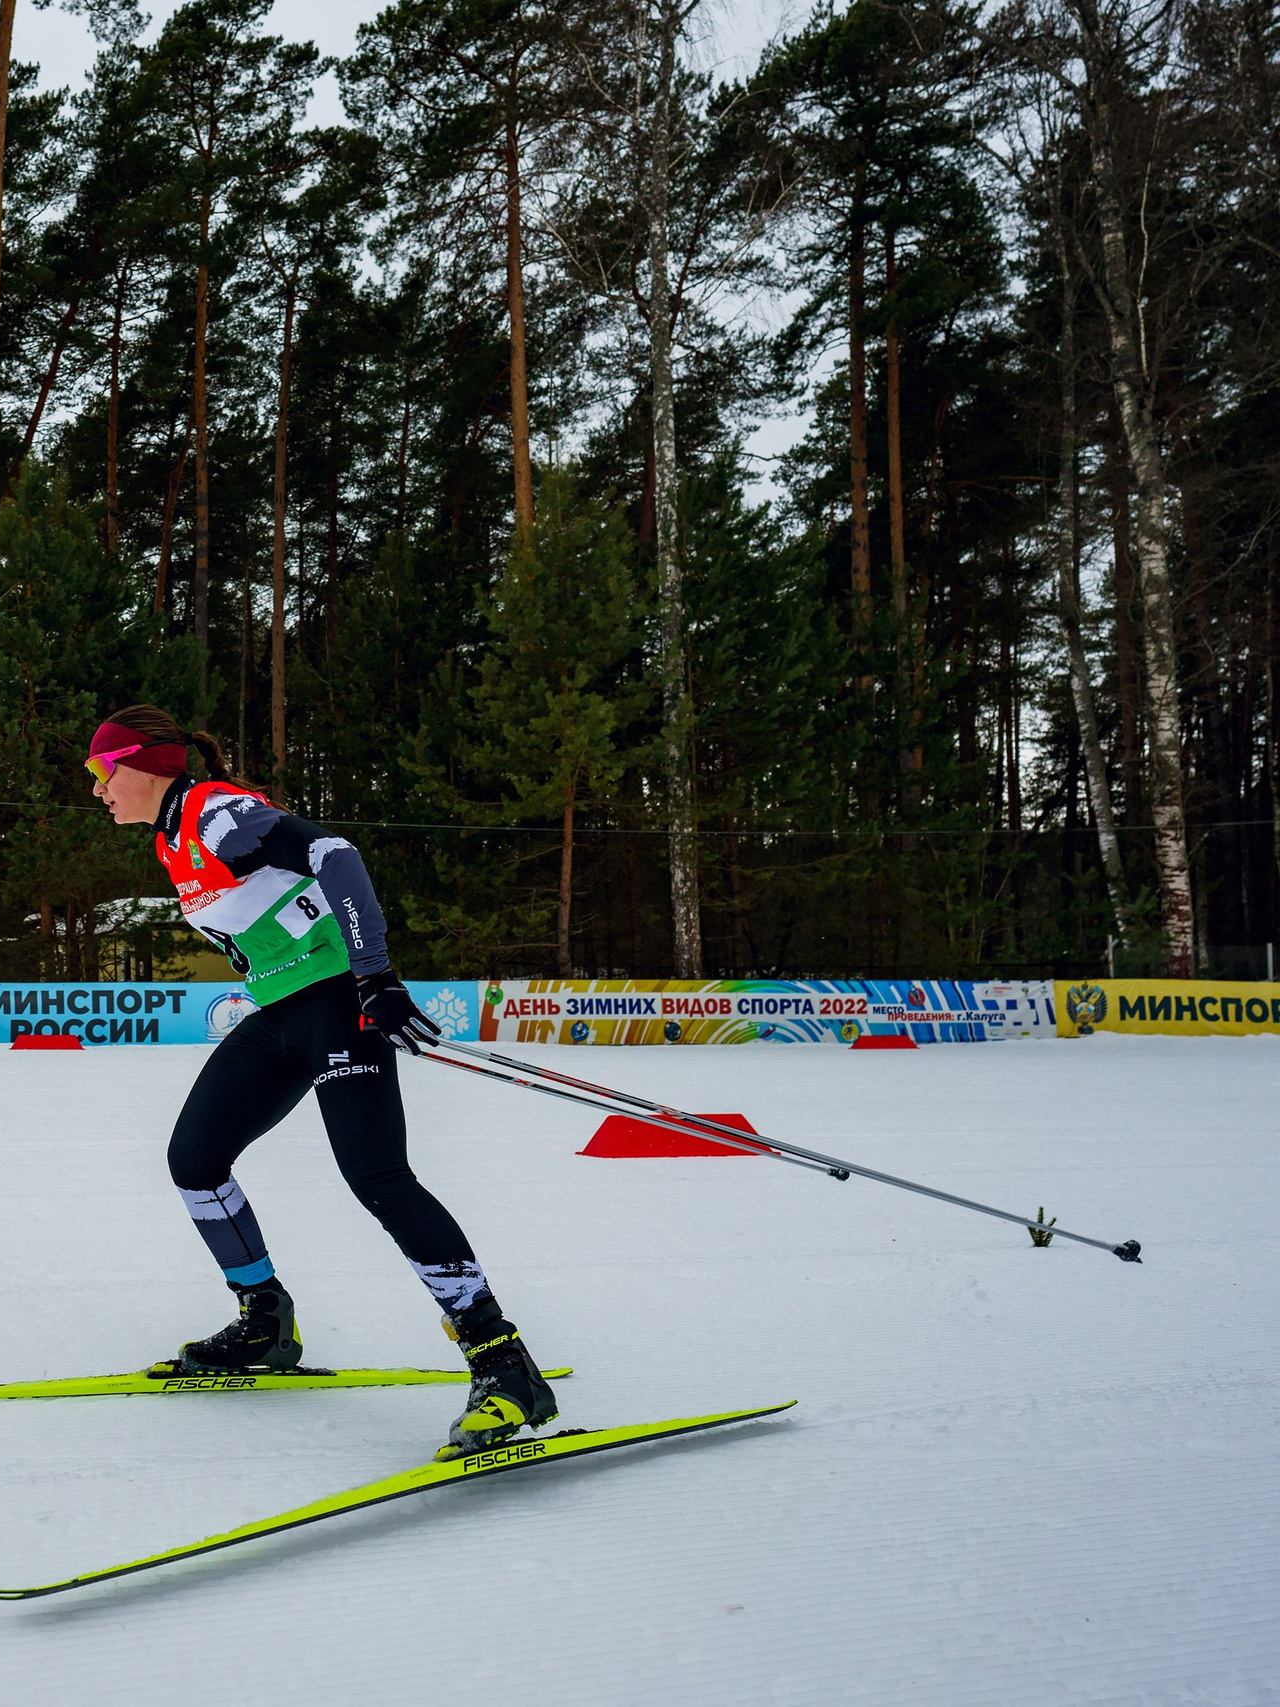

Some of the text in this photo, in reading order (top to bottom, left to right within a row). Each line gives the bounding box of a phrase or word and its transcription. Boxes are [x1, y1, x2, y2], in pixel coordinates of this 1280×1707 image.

[296, 895, 320, 921] 8
[342, 897, 364, 950] ORDSKI
[503, 998, 868, 1019] ДЕНЬ ЗИМНИХ ВИДОВ СПОРТА 2022
[872, 1006, 905, 1015] МЕСТО
[10, 1018, 159, 1043] РОССИИ
[313, 1065, 380, 1087] NORDSKI
[162, 1377, 257, 1390] FISCHER
[463, 1443, 547, 1472] FISCHER
